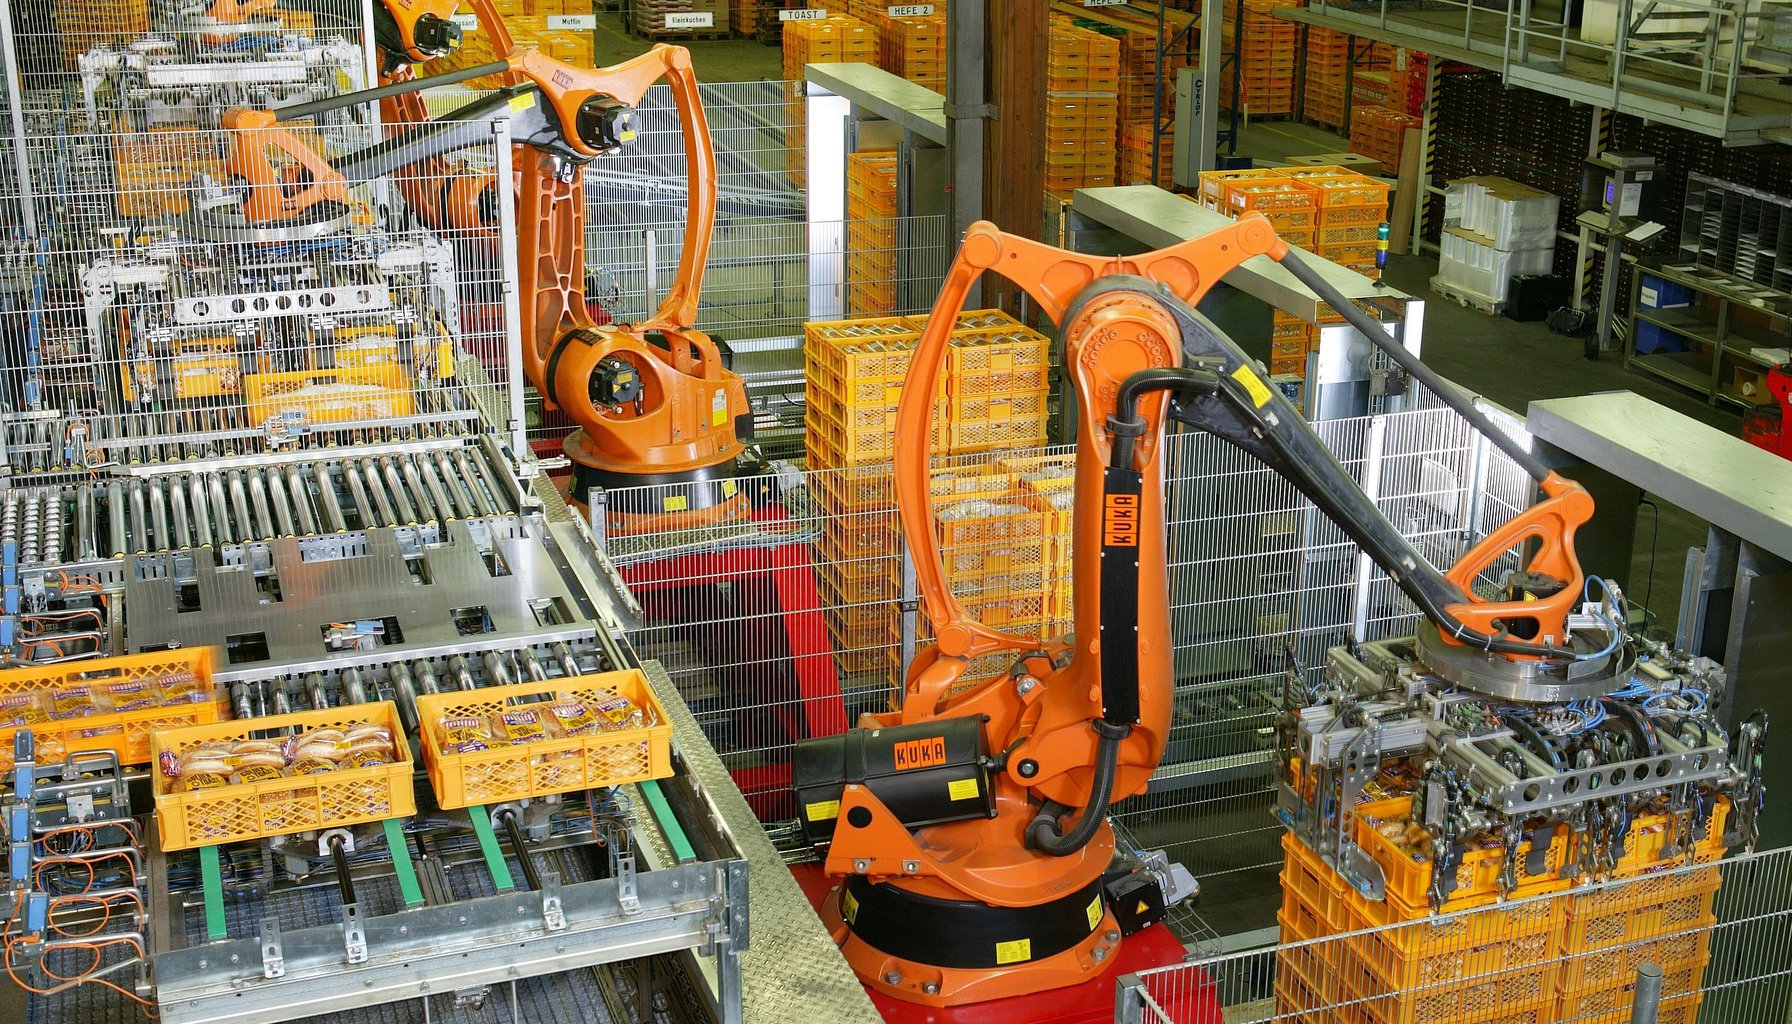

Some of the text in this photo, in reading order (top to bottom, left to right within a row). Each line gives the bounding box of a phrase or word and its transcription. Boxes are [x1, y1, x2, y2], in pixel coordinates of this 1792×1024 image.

[788, 10, 818, 19] TOAST
[894, 6, 928, 15] HEFE 2
[672, 16, 707, 24] Kleinkuchen
[1112, 496, 1133, 544] KUKA
[896, 743, 944, 765] KUKA
[240, 766, 267, 777] GOLDEN
[254, 768, 275, 778] TOAST
[200, 777, 220, 786] TOAST
